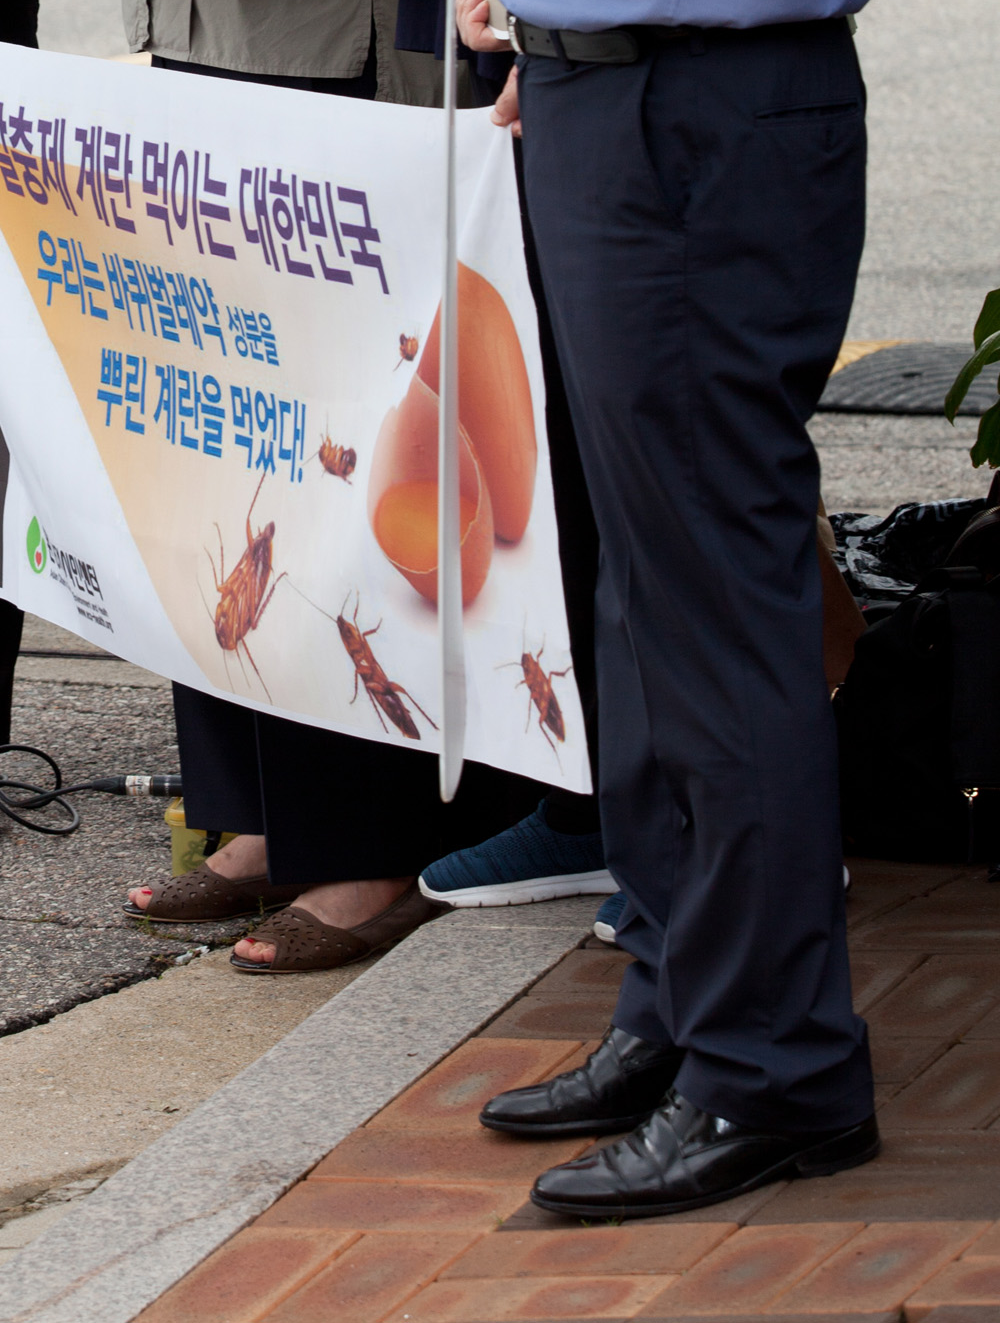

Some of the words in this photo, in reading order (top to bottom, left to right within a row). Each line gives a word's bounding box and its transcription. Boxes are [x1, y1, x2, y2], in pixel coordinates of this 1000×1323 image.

[74, 125, 137, 235] 계란
[141, 140, 237, 261] 먹이는
[240, 166, 390, 295] 대한민국
[37, 229, 109, 321] 우리는
[102, 252, 227, 357] 바퀴벌레약
[226, 305, 280, 367] 성분을
[97, 347, 147, 436] 뿌린
[153, 364, 226, 459] 계란을
[229, 384, 306, 484] 먹었다!
